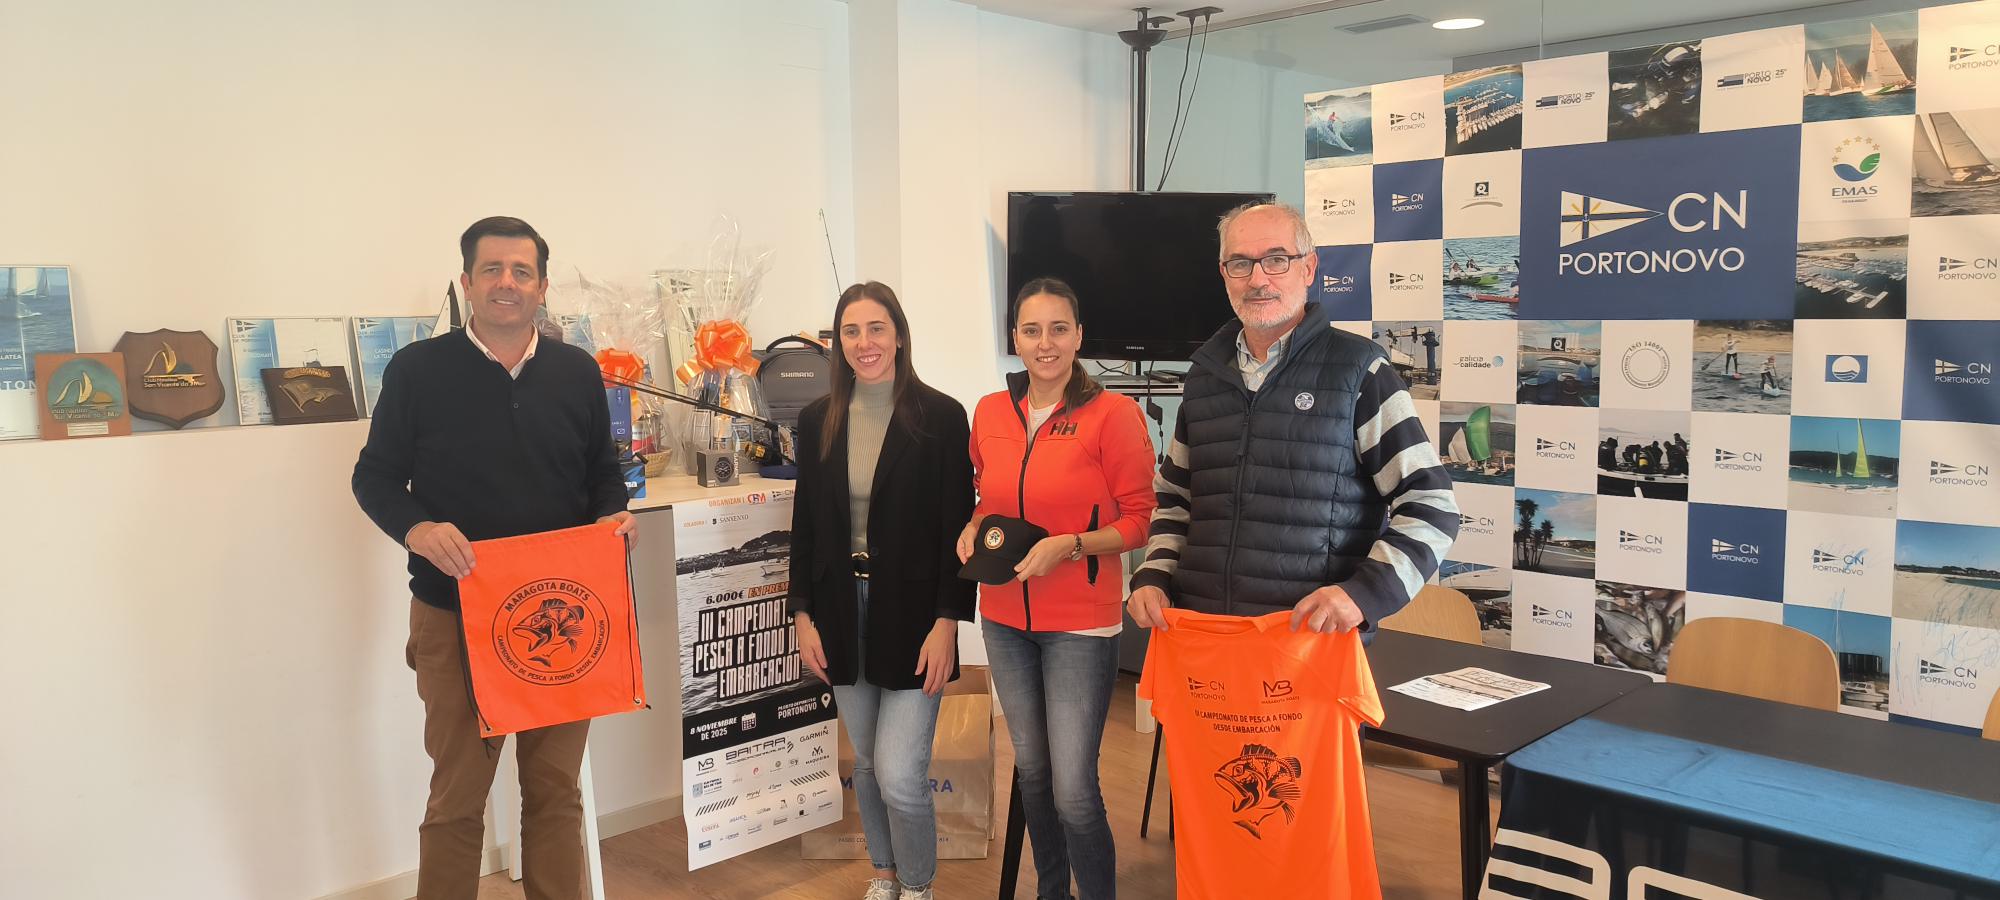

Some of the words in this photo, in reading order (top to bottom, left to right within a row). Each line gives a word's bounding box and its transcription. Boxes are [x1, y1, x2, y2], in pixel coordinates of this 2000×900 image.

[1410, 112, 1425, 121] CN
[1390, 123, 1426, 132] PORTONOVO
[1832, 186, 1878, 196] EMAS
[1411, 194, 1424, 202] CN
[1341, 200, 1356, 208] CN
[1392, 204, 1423, 212] PORTONOVO
[1668, 190, 1748, 233] CN
[1559, 247, 1745, 276] PORTONOVO
[1974, 258, 1998, 269] CN
[1342, 276, 1354, 284] CN
[1410, 274, 1424, 282] CN
[1460, 355, 1484, 363] galicia
[1968, 363, 1992, 374] CN
[1935, 376, 1990, 385] PORTONOVO
[1050, 421, 1078, 435] HH
[1560, 442, 1576, 450] CN
[1742, 452, 1762, 462] CN
[1965, 465, 1988, 476] CN
[1930, 477, 1988, 486] PORTONOVO
[1480, 518, 1494, 526] CN
[1645, 534, 1662, 545] CN
[1620, 544, 1662, 554] PORTONOVO
[1740, 544, 1759, 554] CN
[1712, 554, 1758, 564] PORTONOVO
[1844, 555, 1864, 565] CN
[1812, 565, 1864, 576] PORTONOVO
[505, 582, 556, 612] MARAGOTA
[560, 582, 590, 601] BOATS
[706, 590, 744, 605] 6.000€
[748, 586, 760, 598] EN
[1556, 610, 1572, 620] CN
[701, 612, 714, 641] III
[1532, 618, 1572, 628] PORTONOVO
[696, 639, 733, 674] PESCA
[737, 636, 744, 664] A
[748, 628, 785, 662] FONDO
[497, 635, 518, 669] CAMPEONATO
[528, 673, 546, 681] PESCA
[576, 660, 592, 673] DESDE
[1954, 667, 1977, 679] CN
[1210, 681, 1225, 691] CN
[1920, 675, 1976, 690] PORTONOVO
[1190, 692, 1225, 700] PORTONOVO
[778, 702, 817, 719] PORTONOVO
[1200, 711, 1238, 722] CAMPEONATO
[696, 717, 738, 733] NOVIEMBRE
[1213, 723, 1231, 732] DESDE
[1232, 724, 1281, 733] EMBARCACIÓN
[701, 732, 709, 740] DE
[711, 727, 728, 738] 2025
[800, 730, 828, 742] GARMIN
[726, 737, 785, 760] BAITRA
